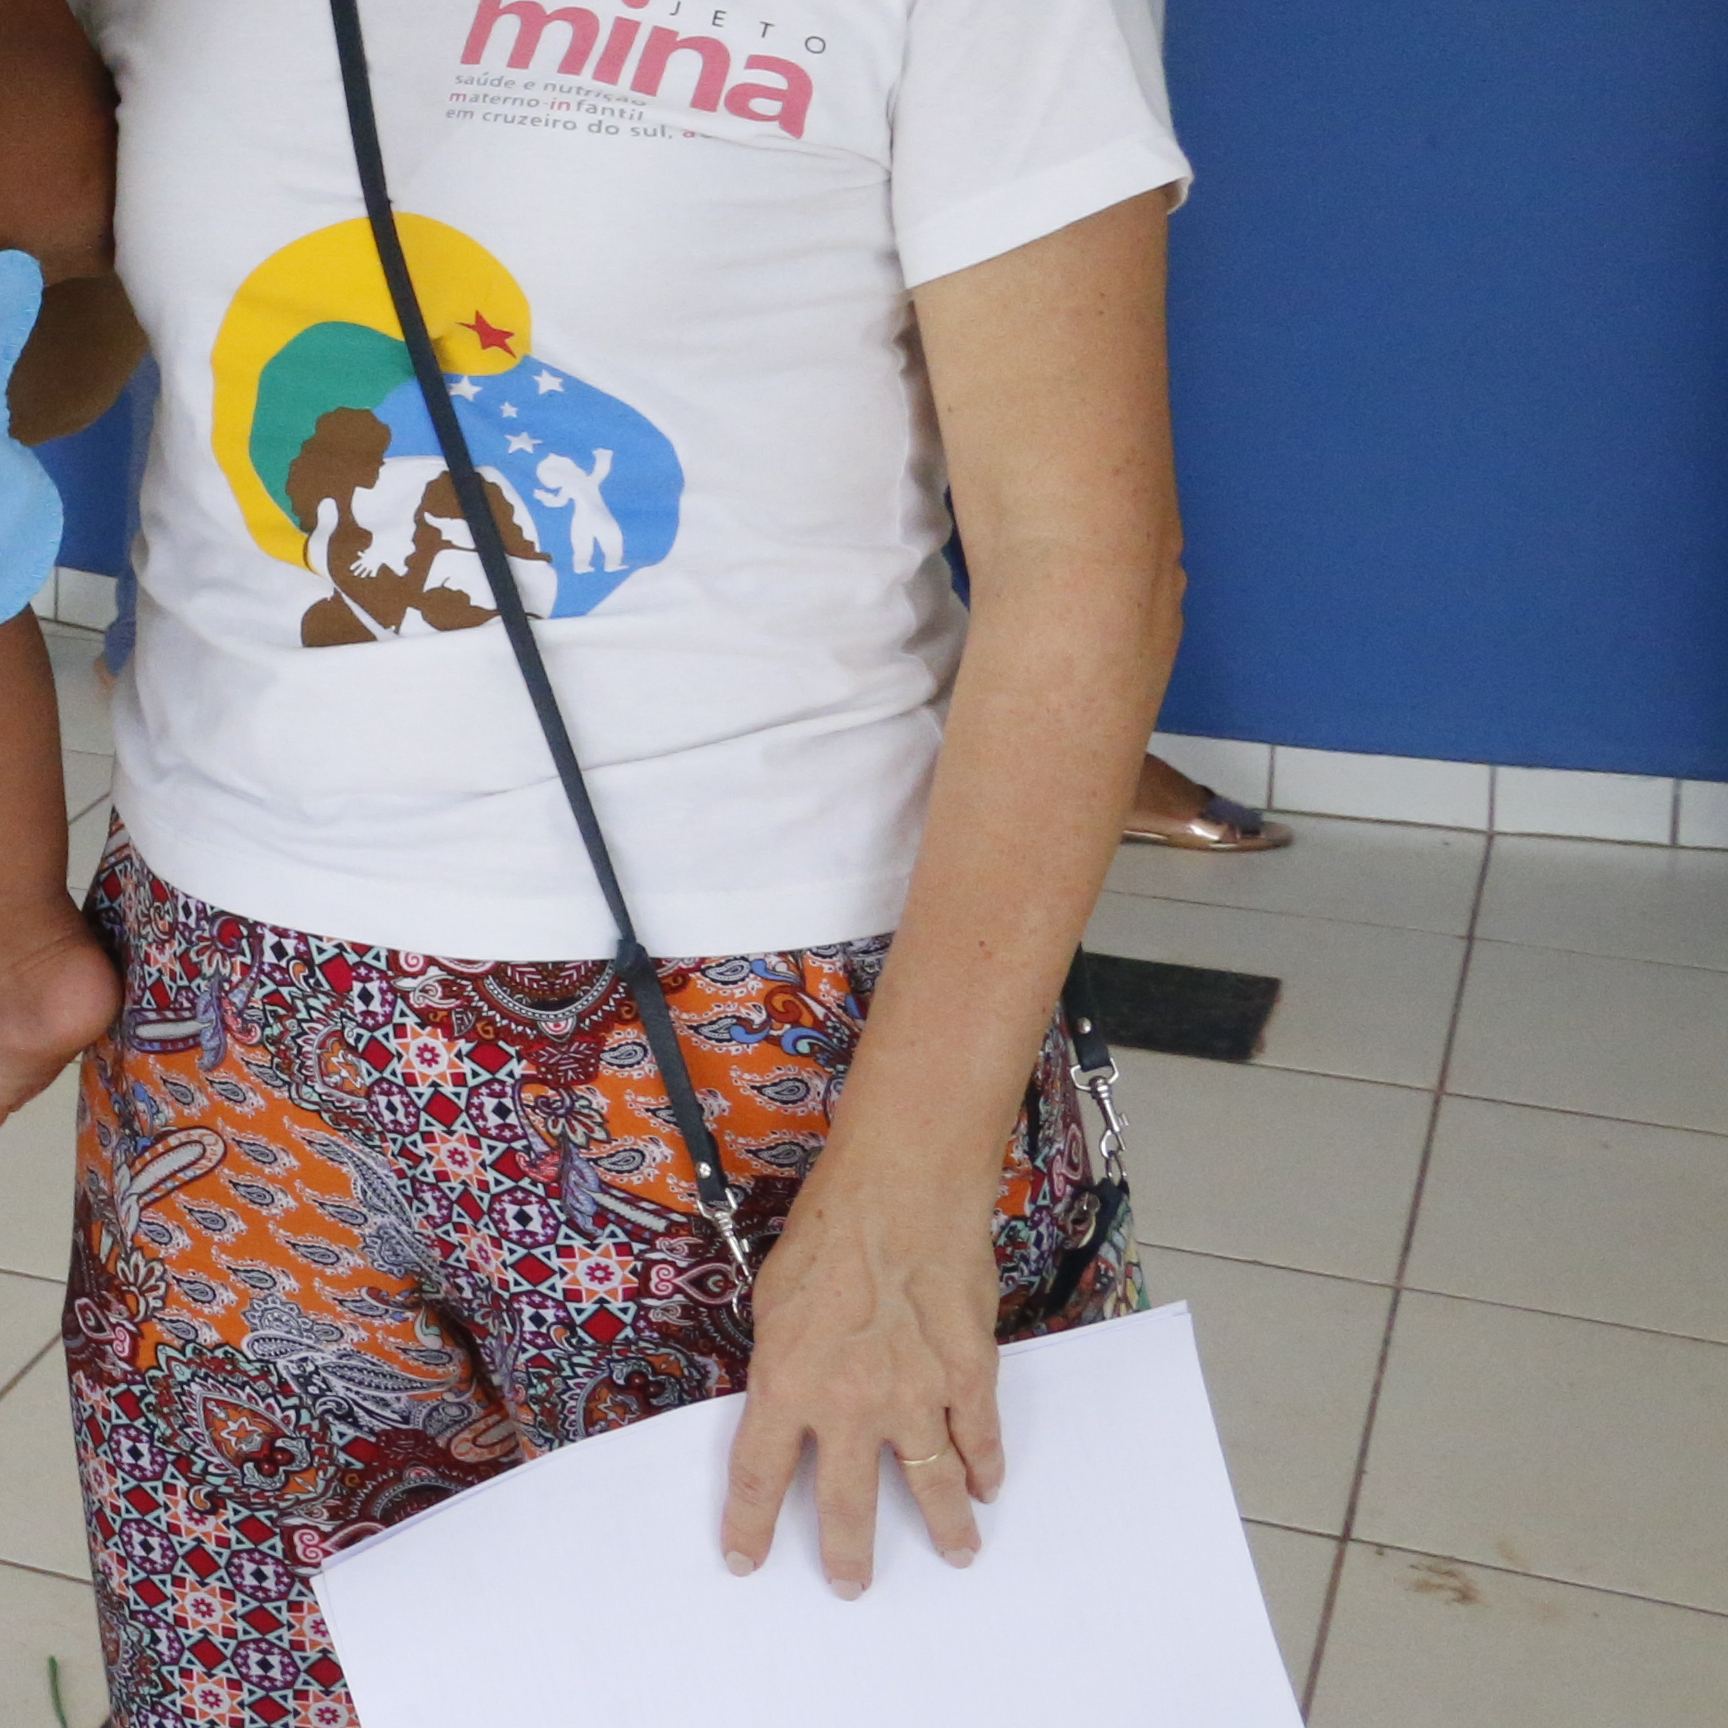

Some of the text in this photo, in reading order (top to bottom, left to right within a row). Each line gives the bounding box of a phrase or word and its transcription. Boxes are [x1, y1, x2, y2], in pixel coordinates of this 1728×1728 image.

[454, 71, 516, 90] saúde
[522, 79, 536, 90] e
[448, 90, 645, 122] materno-infantil
[445, 108, 475, 120] em
[481, 110, 578, 131] cruzeiro
[587, 118, 621, 136] do
[629, 123, 674, 140] sul,
